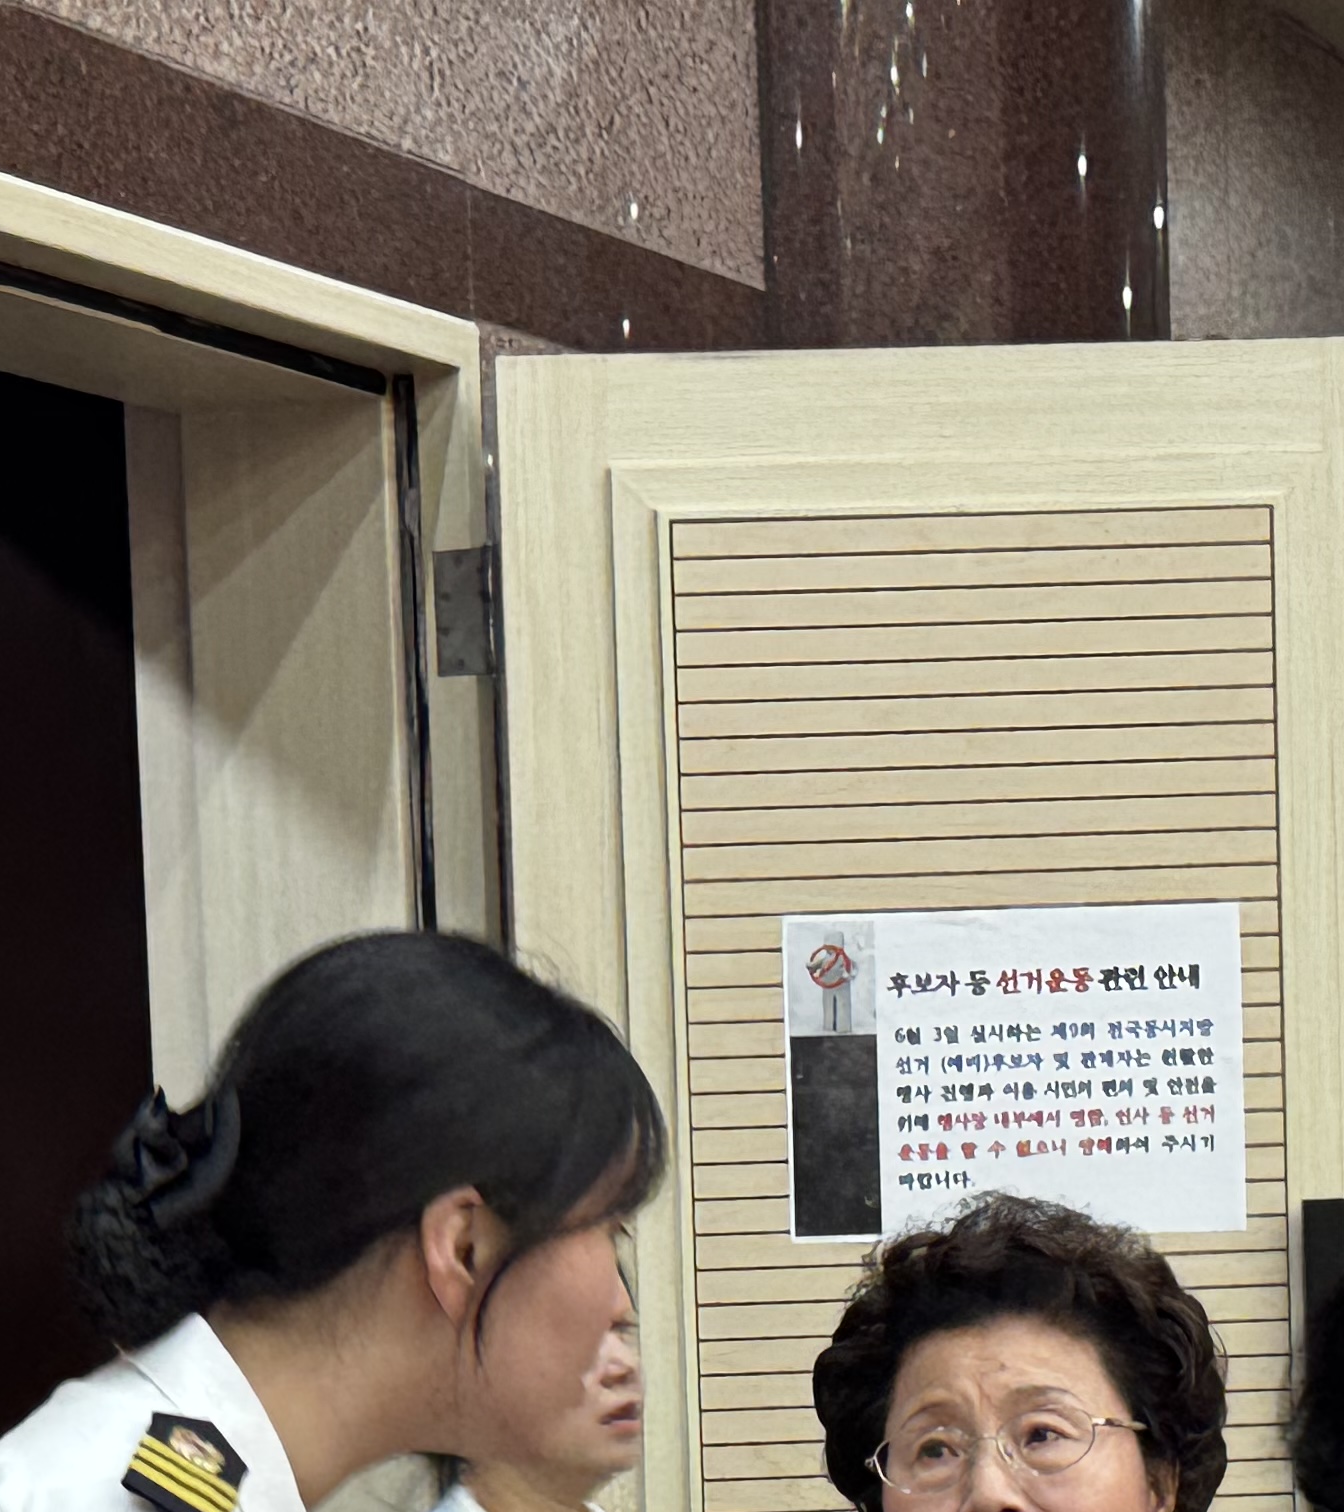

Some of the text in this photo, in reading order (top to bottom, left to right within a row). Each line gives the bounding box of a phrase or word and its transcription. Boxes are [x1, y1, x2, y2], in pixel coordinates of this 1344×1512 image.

[886, 970, 961, 999] 후보자
[964, 970, 991, 996] 등
[996, 967, 1094, 995] 선거운동
[1153, 963, 1200, 990] 안내
